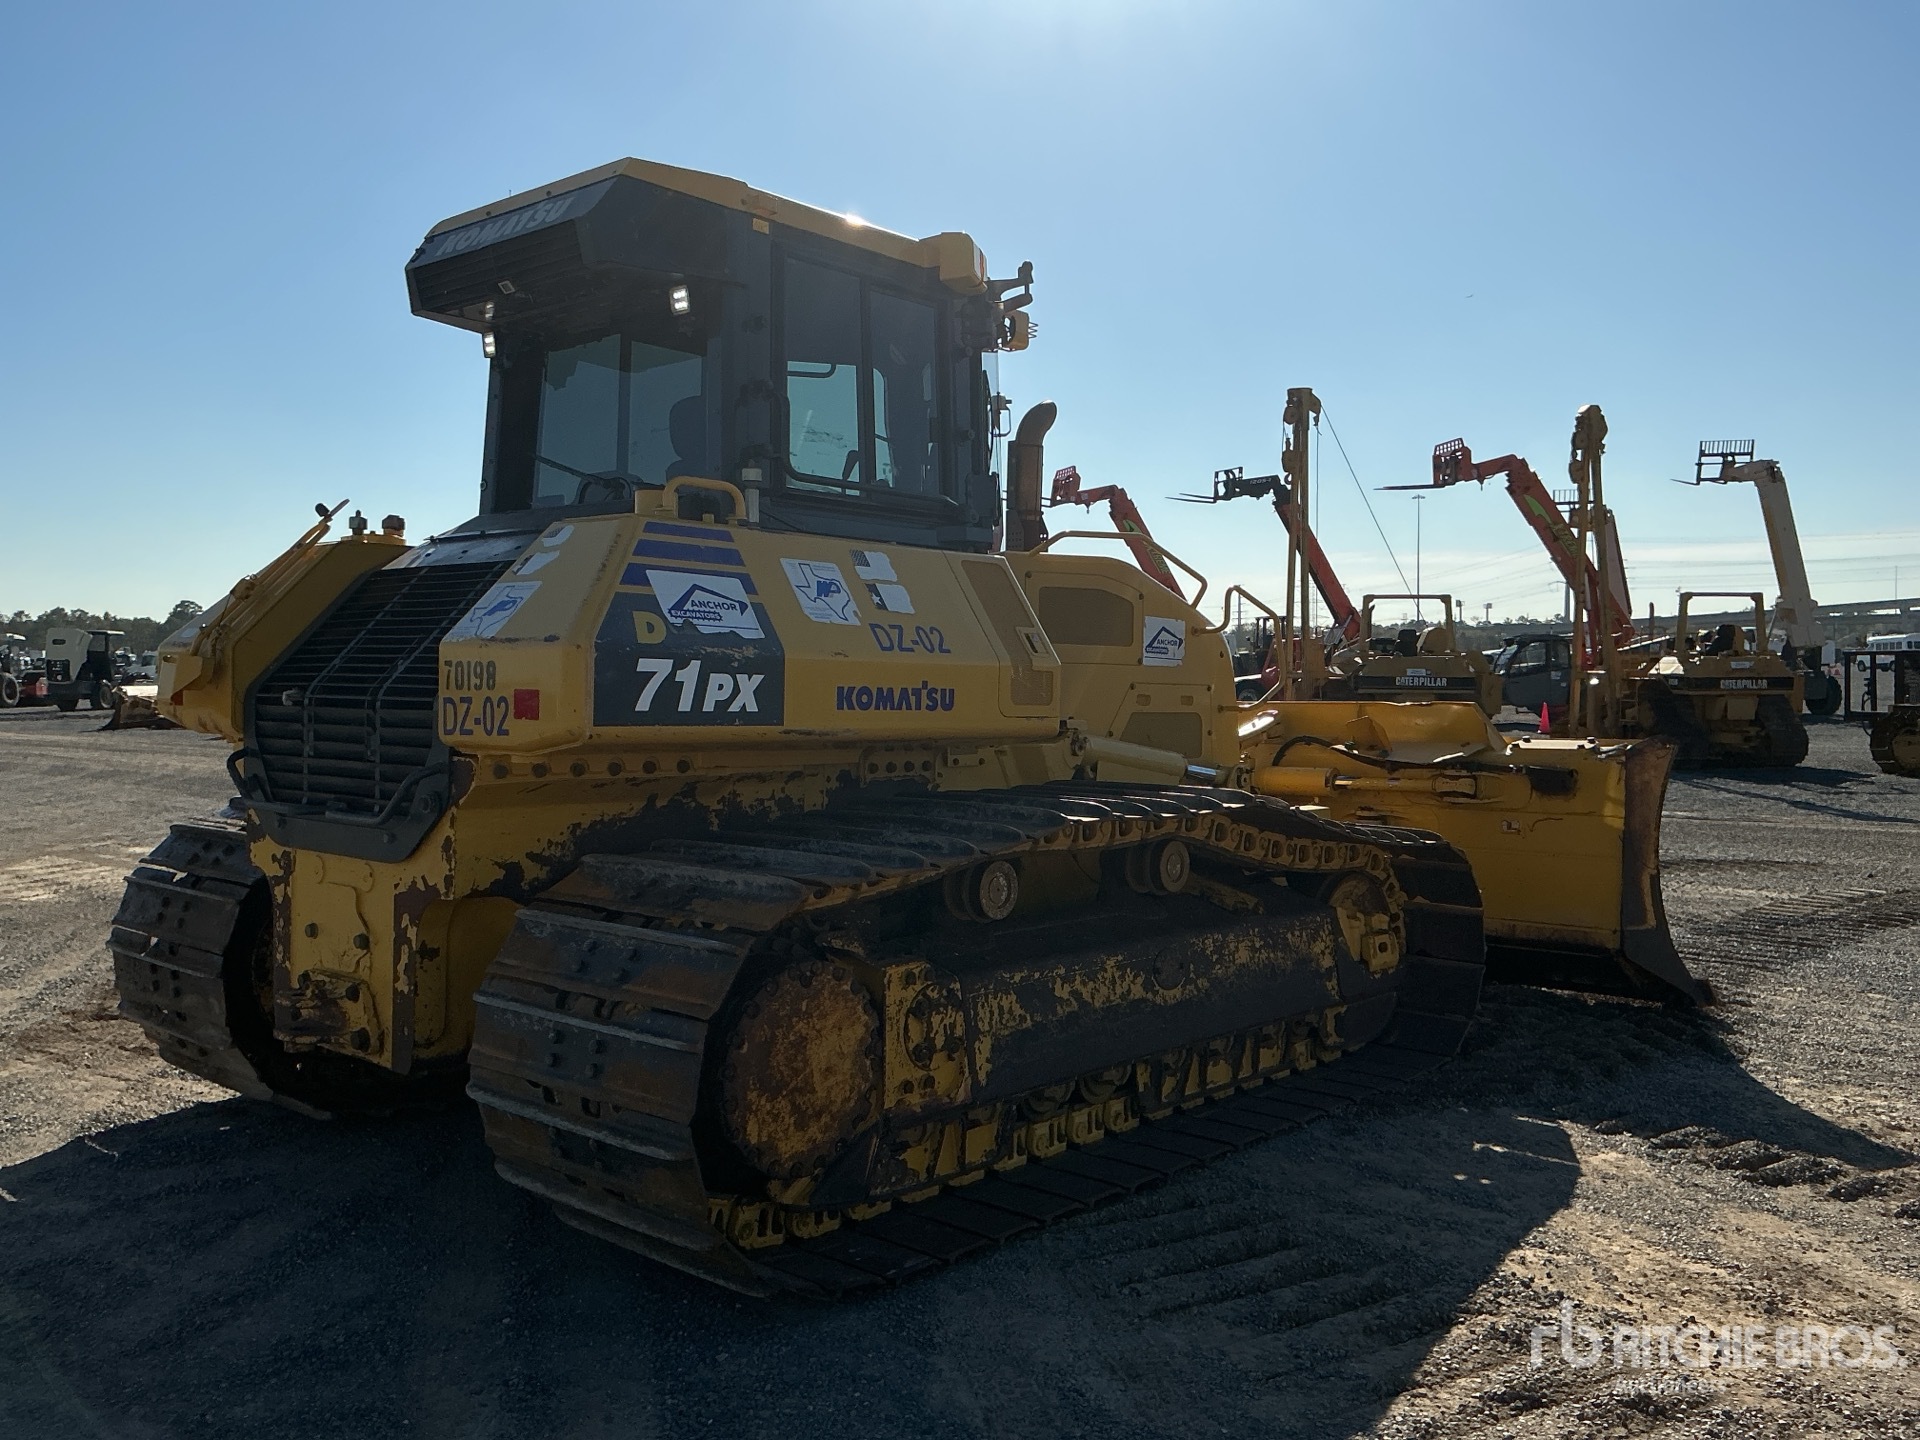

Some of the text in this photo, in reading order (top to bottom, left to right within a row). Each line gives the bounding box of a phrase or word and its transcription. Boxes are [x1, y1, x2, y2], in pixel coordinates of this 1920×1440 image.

[435, 197, 576, 256] KOMATSU
[671, 609, 721, 620] EXCAVATORS
[690, 600, 738, 611] ANCHOR
[632, 610, 667, 644] D
[868, 623, 951, 654] DZ-02
[444, 660, 497, 691] 70198
[1395, 676, 1448, 687] CATERPILLAR
[1720, 679, 1768, 689] CATERPILLAR
[836, 681, 955, 711] KOMATSU
[442, 695, 510, 736] DZ-02
